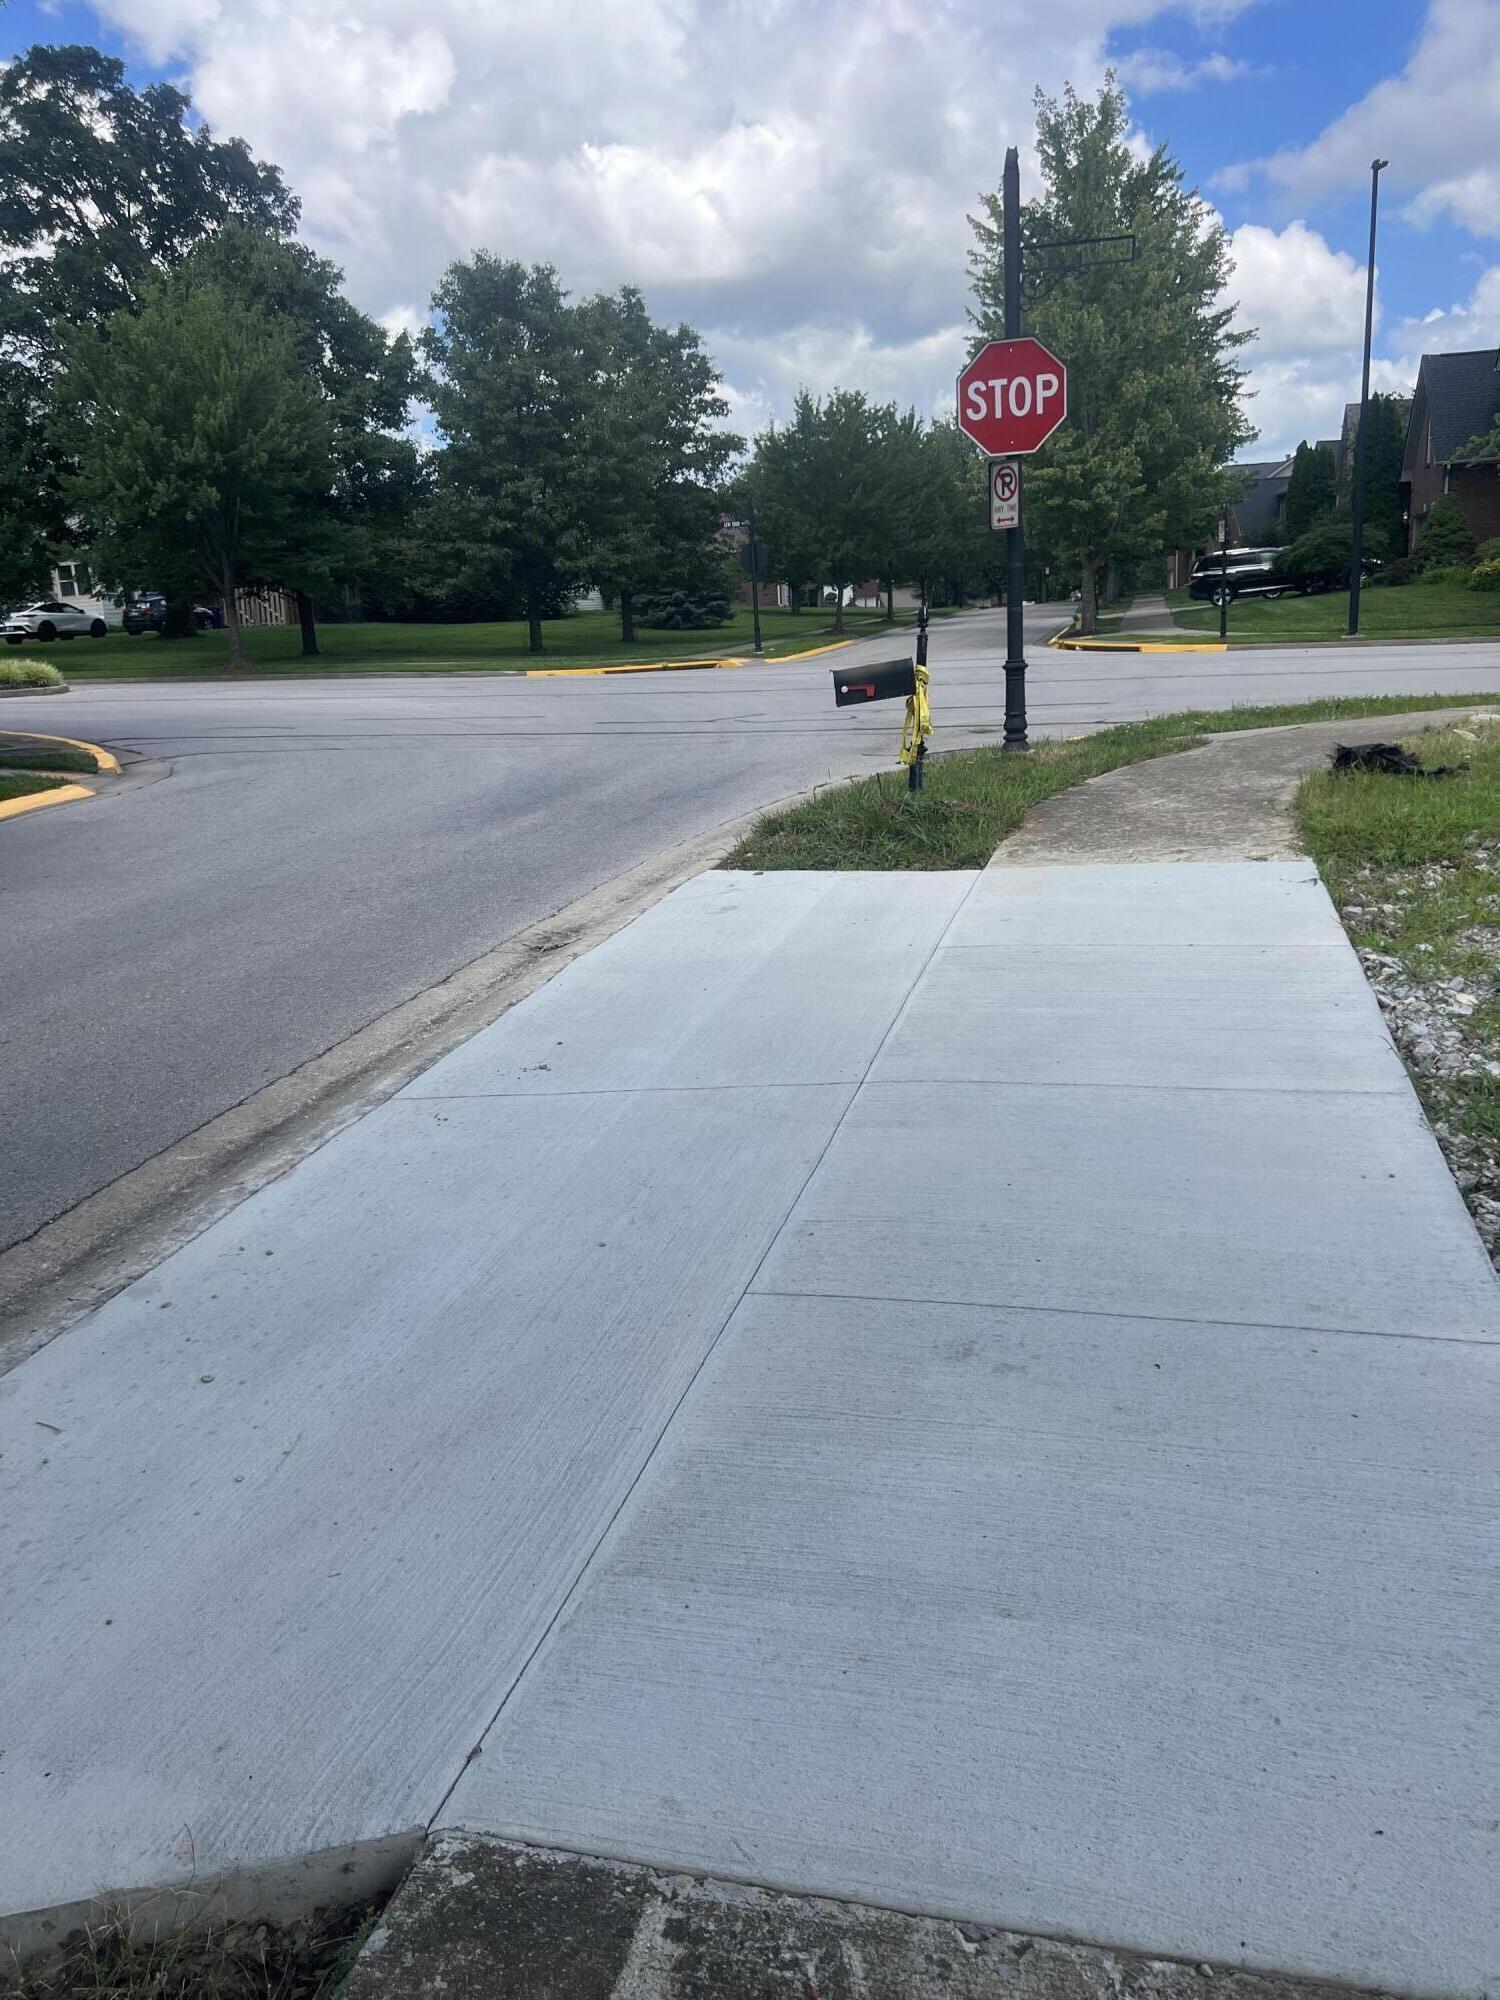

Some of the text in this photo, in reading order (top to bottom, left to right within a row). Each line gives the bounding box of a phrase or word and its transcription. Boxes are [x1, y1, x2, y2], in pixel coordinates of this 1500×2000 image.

[966, 373, 1059, 421] STOP
[994, 503, 1018, 513] ANY TIME
